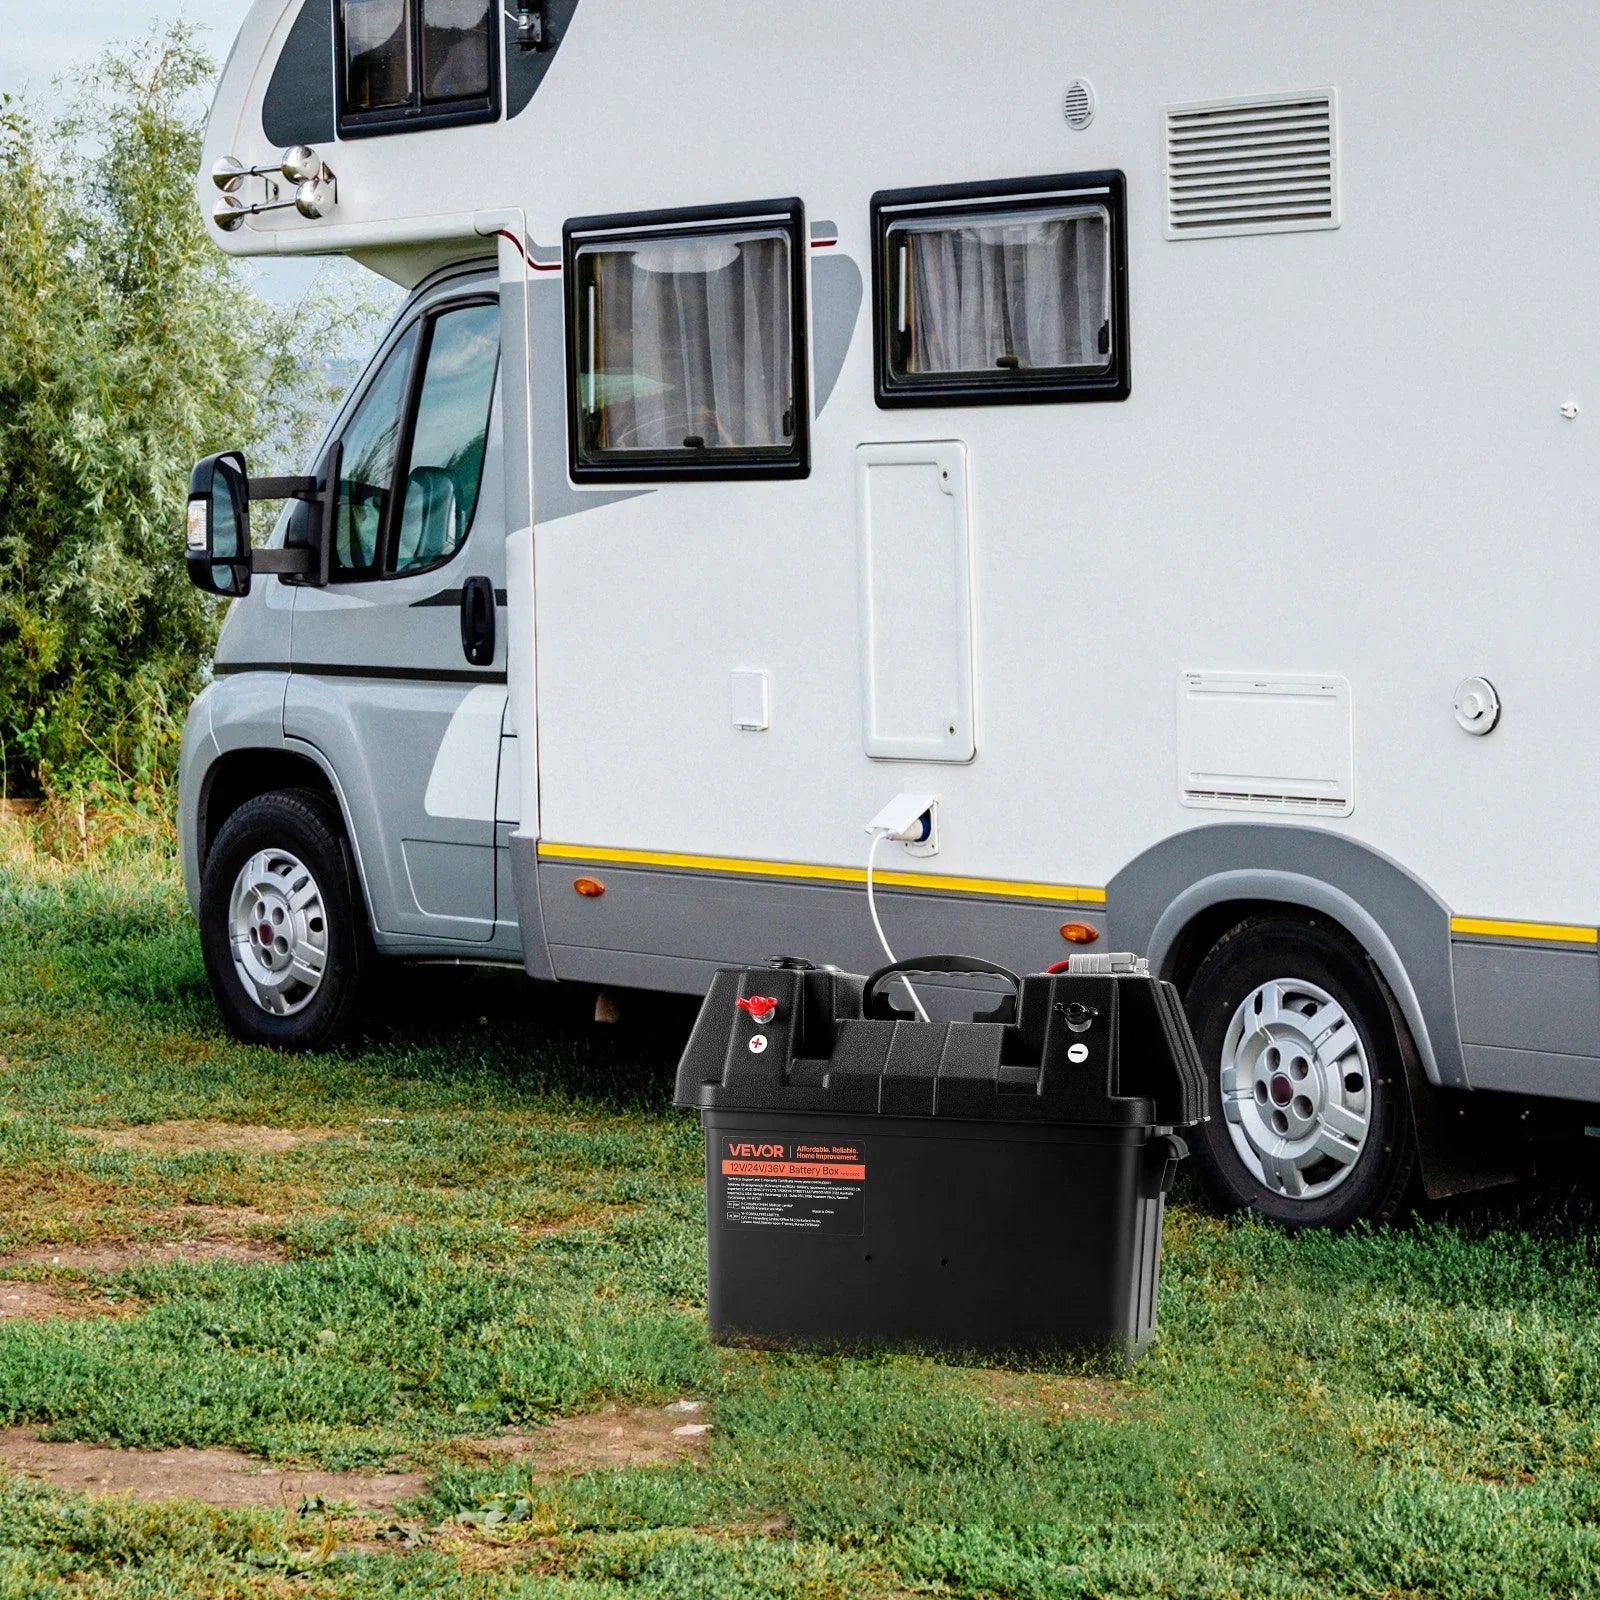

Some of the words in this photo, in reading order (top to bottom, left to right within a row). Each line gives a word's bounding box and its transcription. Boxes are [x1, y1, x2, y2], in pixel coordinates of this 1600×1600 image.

[729, 1143, 784, 1158] VEVOR
[796, 1145, 831, 1153] Affordable.
[730, 1163, 786, 1173] 12V/24V/36V
[789, 1165, 820, 1176] Battery
[822, 1166, 839, 1175] Box
